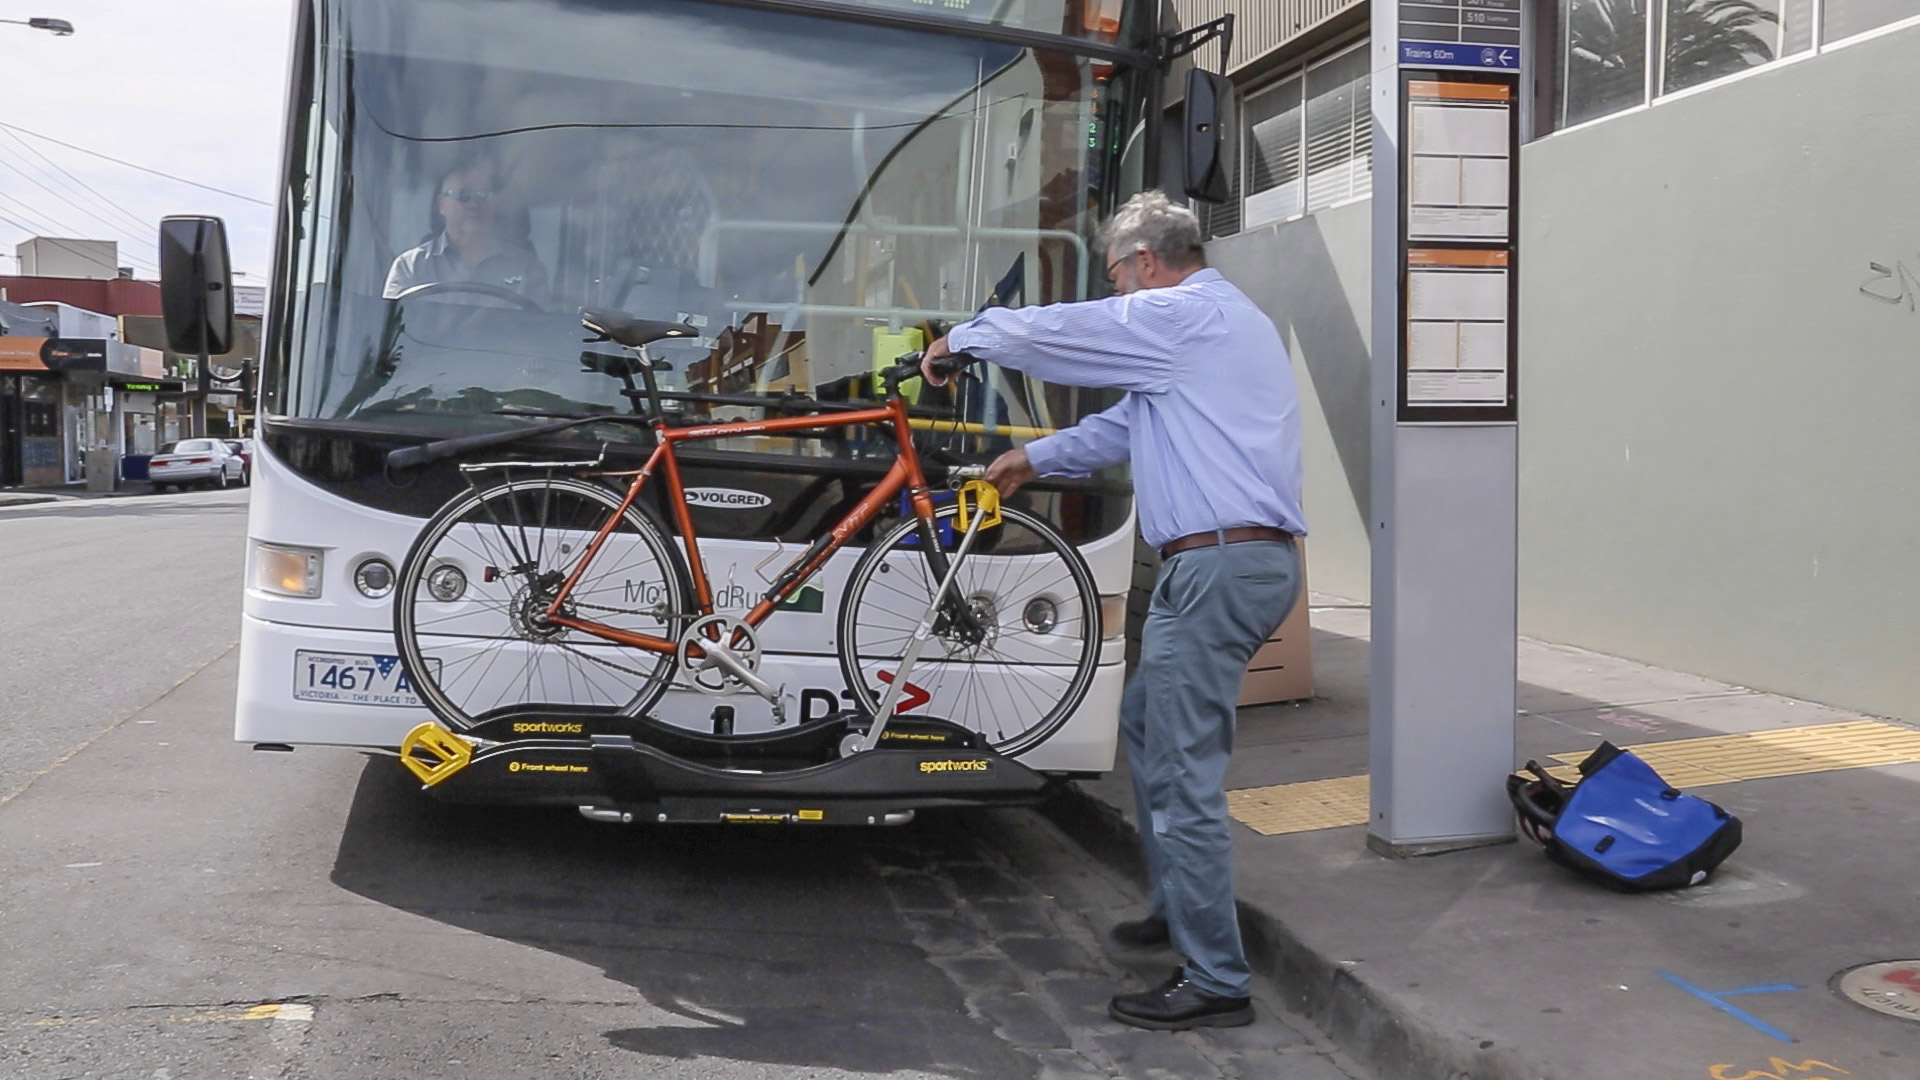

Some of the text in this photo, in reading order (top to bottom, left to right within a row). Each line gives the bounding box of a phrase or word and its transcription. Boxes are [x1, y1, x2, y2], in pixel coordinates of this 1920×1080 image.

[1468, 12, 1485, 23] 510
[1404, 48, 1454, 60] Trains 60m
[700, 492, 764, 506] VOLGREN
[308, 664, 376, 691] 1467
[300, 690, 339, 700] VICTORIA
[352, 693, 369, 702] THE
[373, 695, 400, 704] PLACE
[405, 696, 417, 704] TO
[513, 723, 582, 733] sportworks
[920, 760, 987, 773] sportworks
